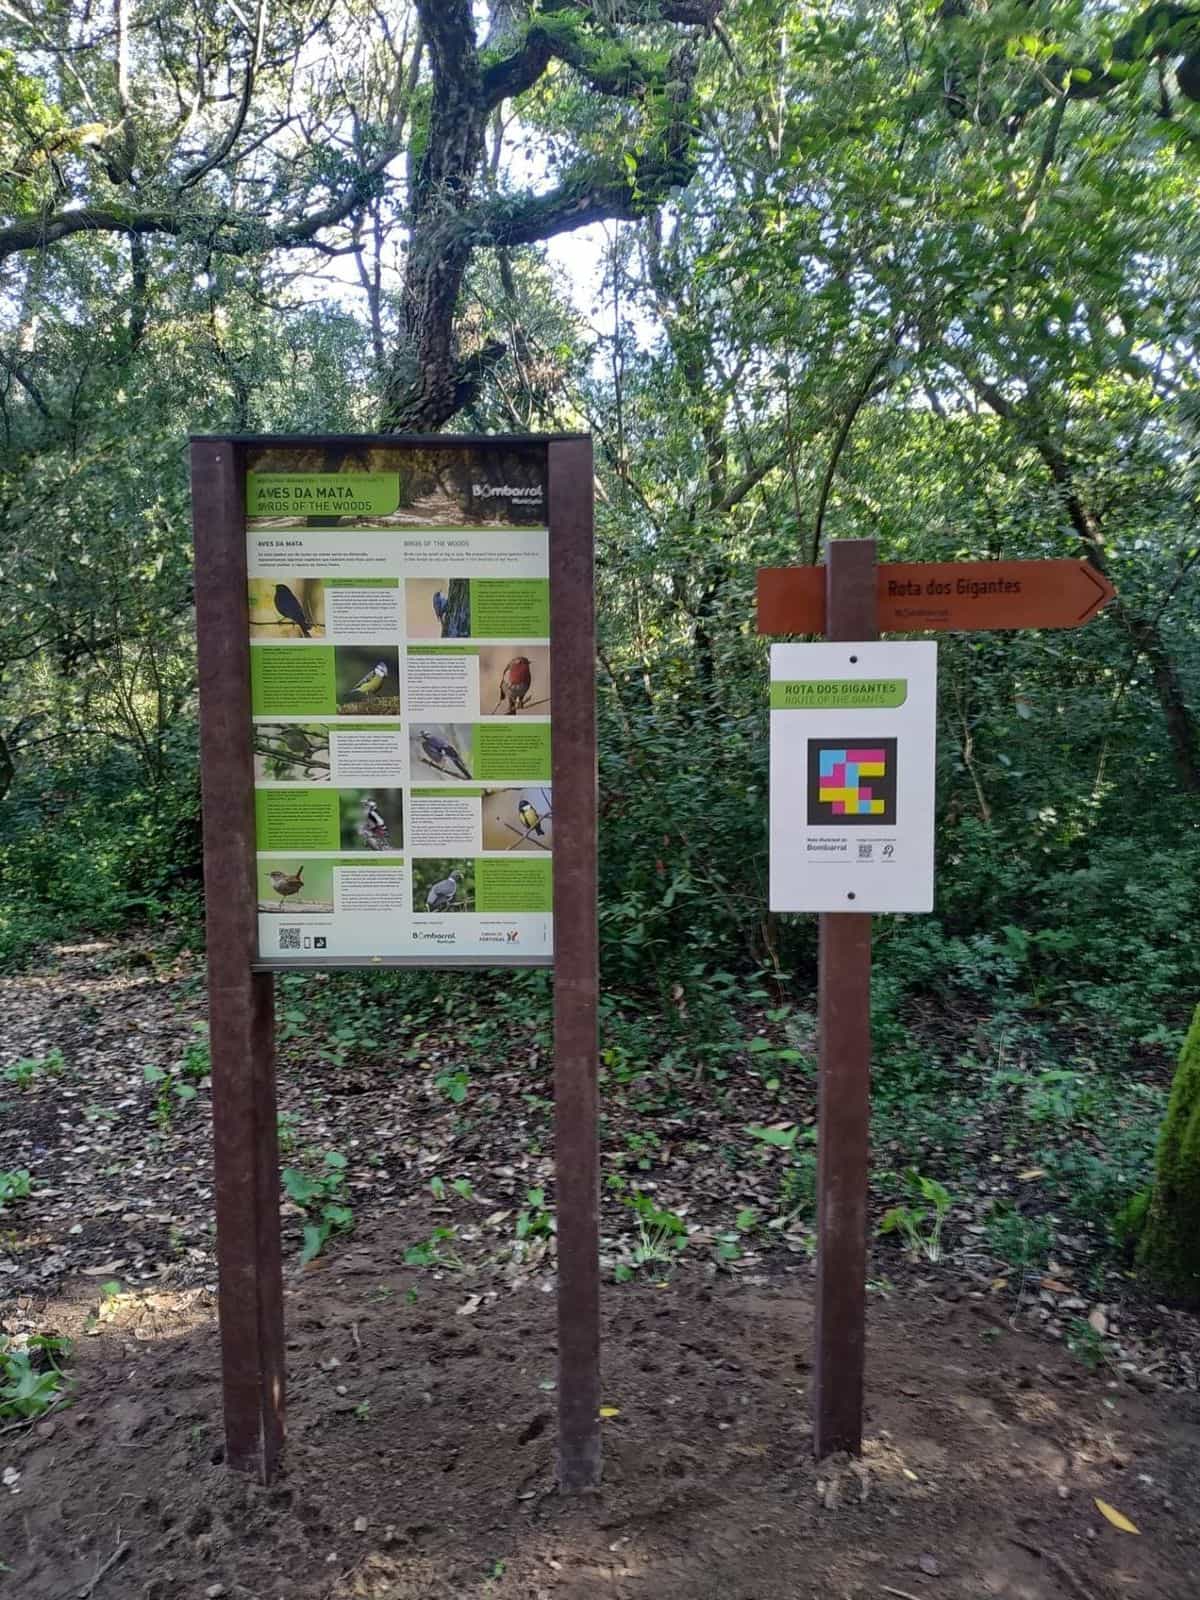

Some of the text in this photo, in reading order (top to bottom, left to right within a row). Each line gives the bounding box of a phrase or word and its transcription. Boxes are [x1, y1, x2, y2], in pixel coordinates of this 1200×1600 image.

[257, 487, 354, 499] AVES DA MATA
[472, 483, 544, 498] Bombarral
[257, 501, 372, 512] BIRDS OF THE WOODS
[887, 578, 1022, 599] Rota dos Gigantes
[784, 683, 897, 695] ROTA DOS GIGANTES
[412, 931, 456, 940] Bombarral
